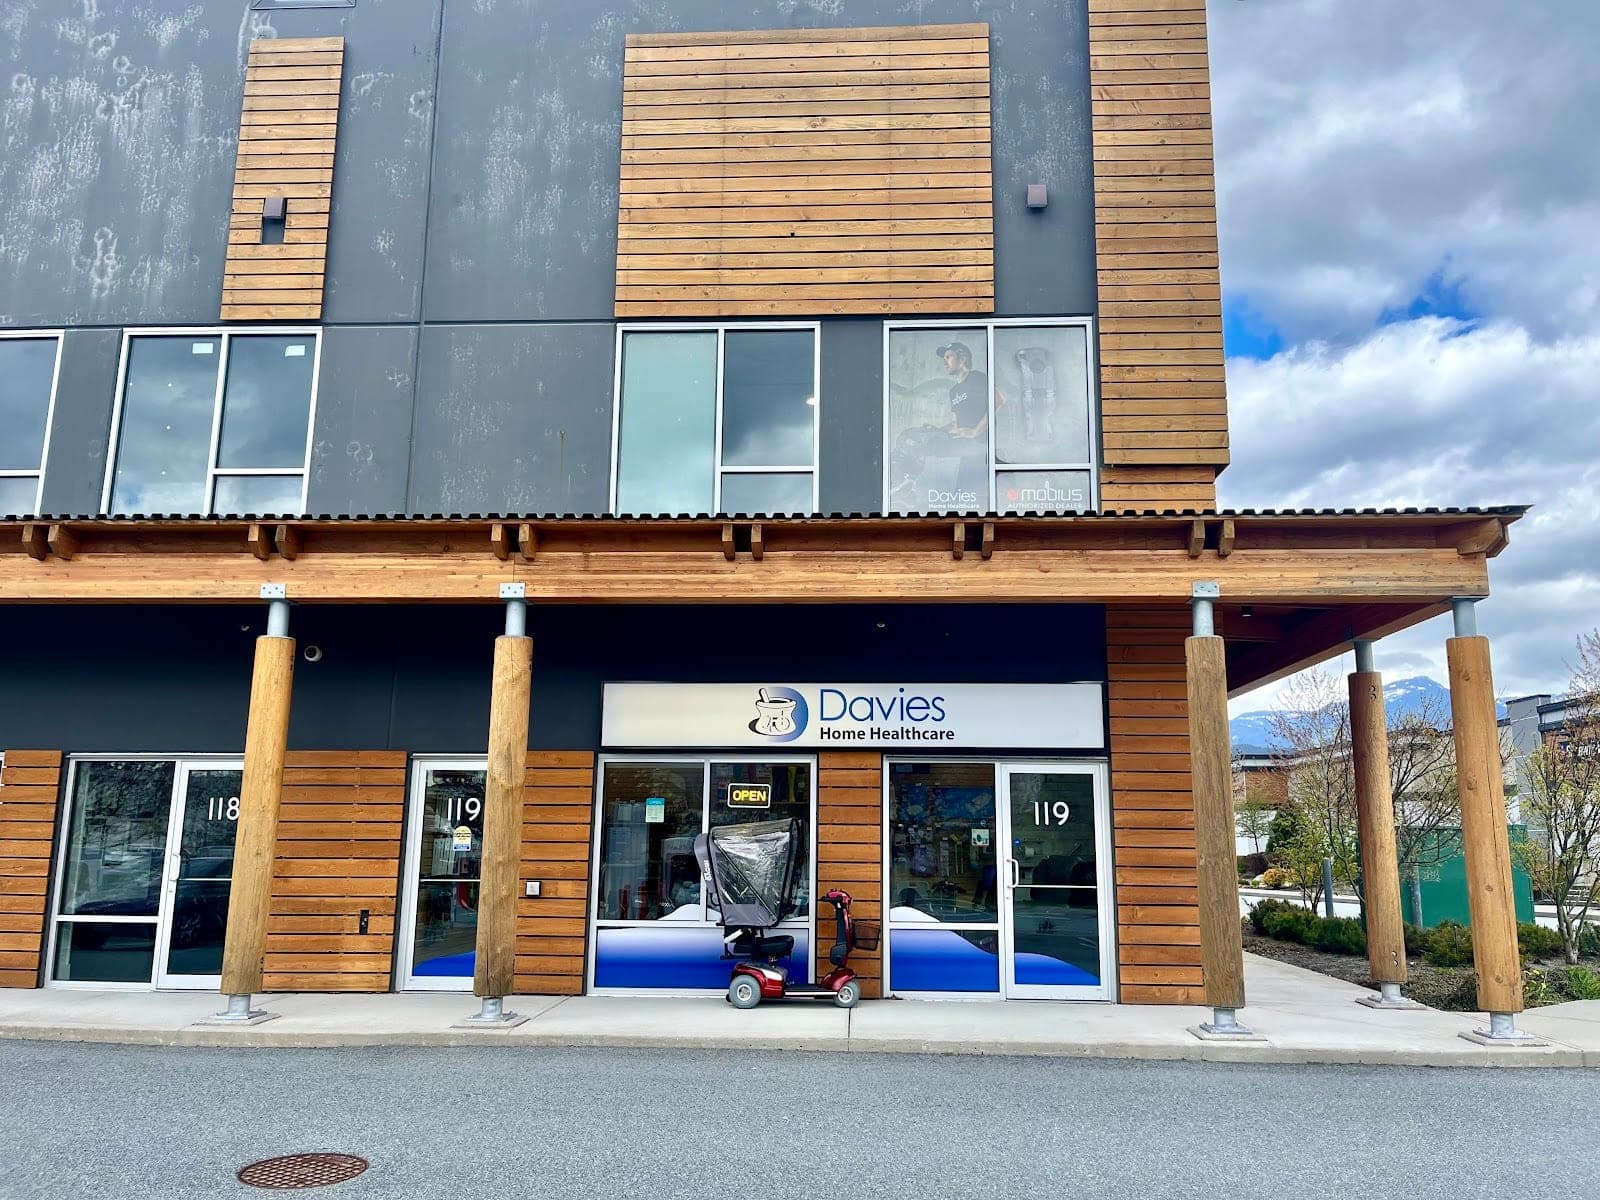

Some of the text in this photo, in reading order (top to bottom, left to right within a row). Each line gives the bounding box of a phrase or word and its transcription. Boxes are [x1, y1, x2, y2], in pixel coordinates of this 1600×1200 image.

[928, 489, 977, 502] Davies
[1021, 480, 1083, 501] mobius
[819, 687, 946, 722] Davies
[819, 727, 955, 740] Home Healthcare
[732, 790, 767, 802] OPEN
[208, 796, 240, 821] 118
[447, 797, 481, 821] 119
[1034, 801, 1070, 826] 119
